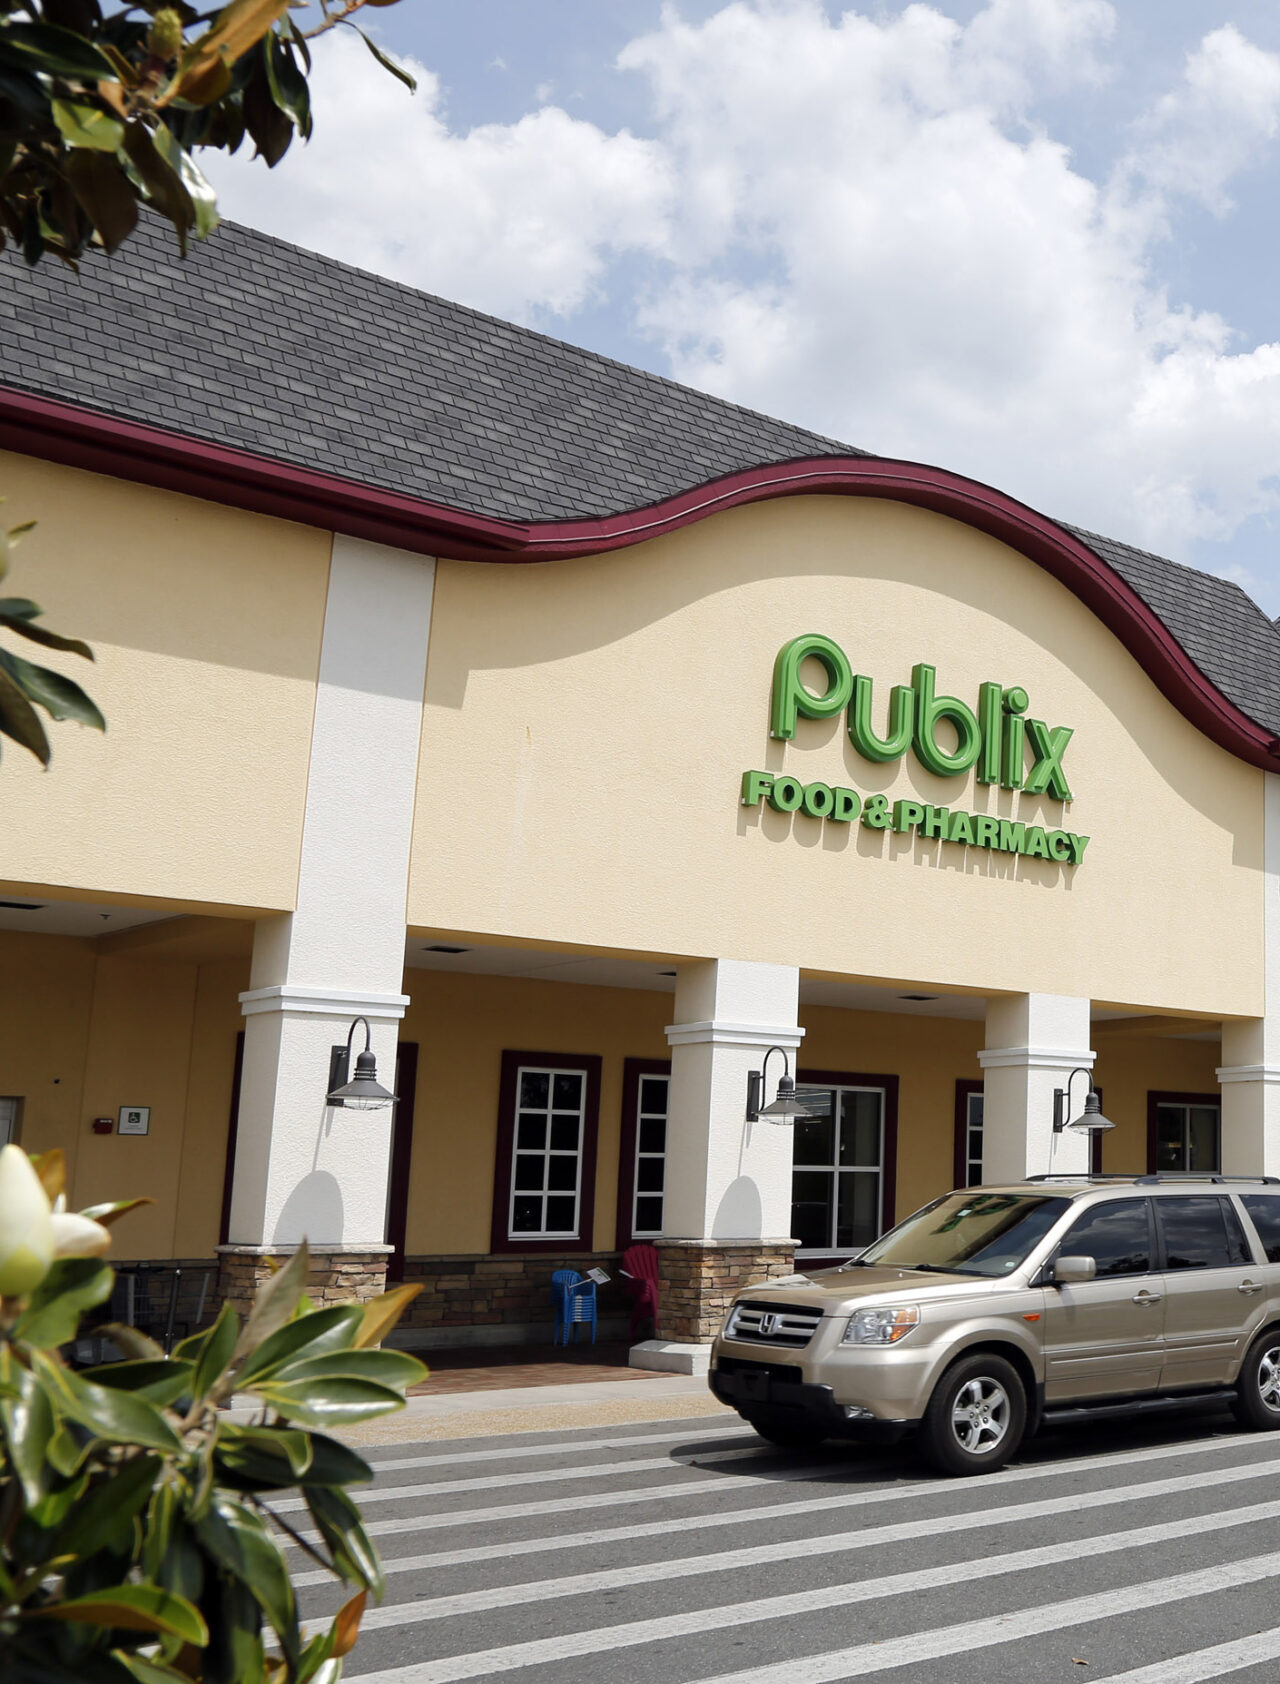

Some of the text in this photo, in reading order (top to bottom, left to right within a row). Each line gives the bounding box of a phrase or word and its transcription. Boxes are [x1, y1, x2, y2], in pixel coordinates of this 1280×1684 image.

[770, 633, 1074, 802] Publix
[741, 769, 861, 822] FOOD
[893, 799, 1091, 865] PHARMACY
